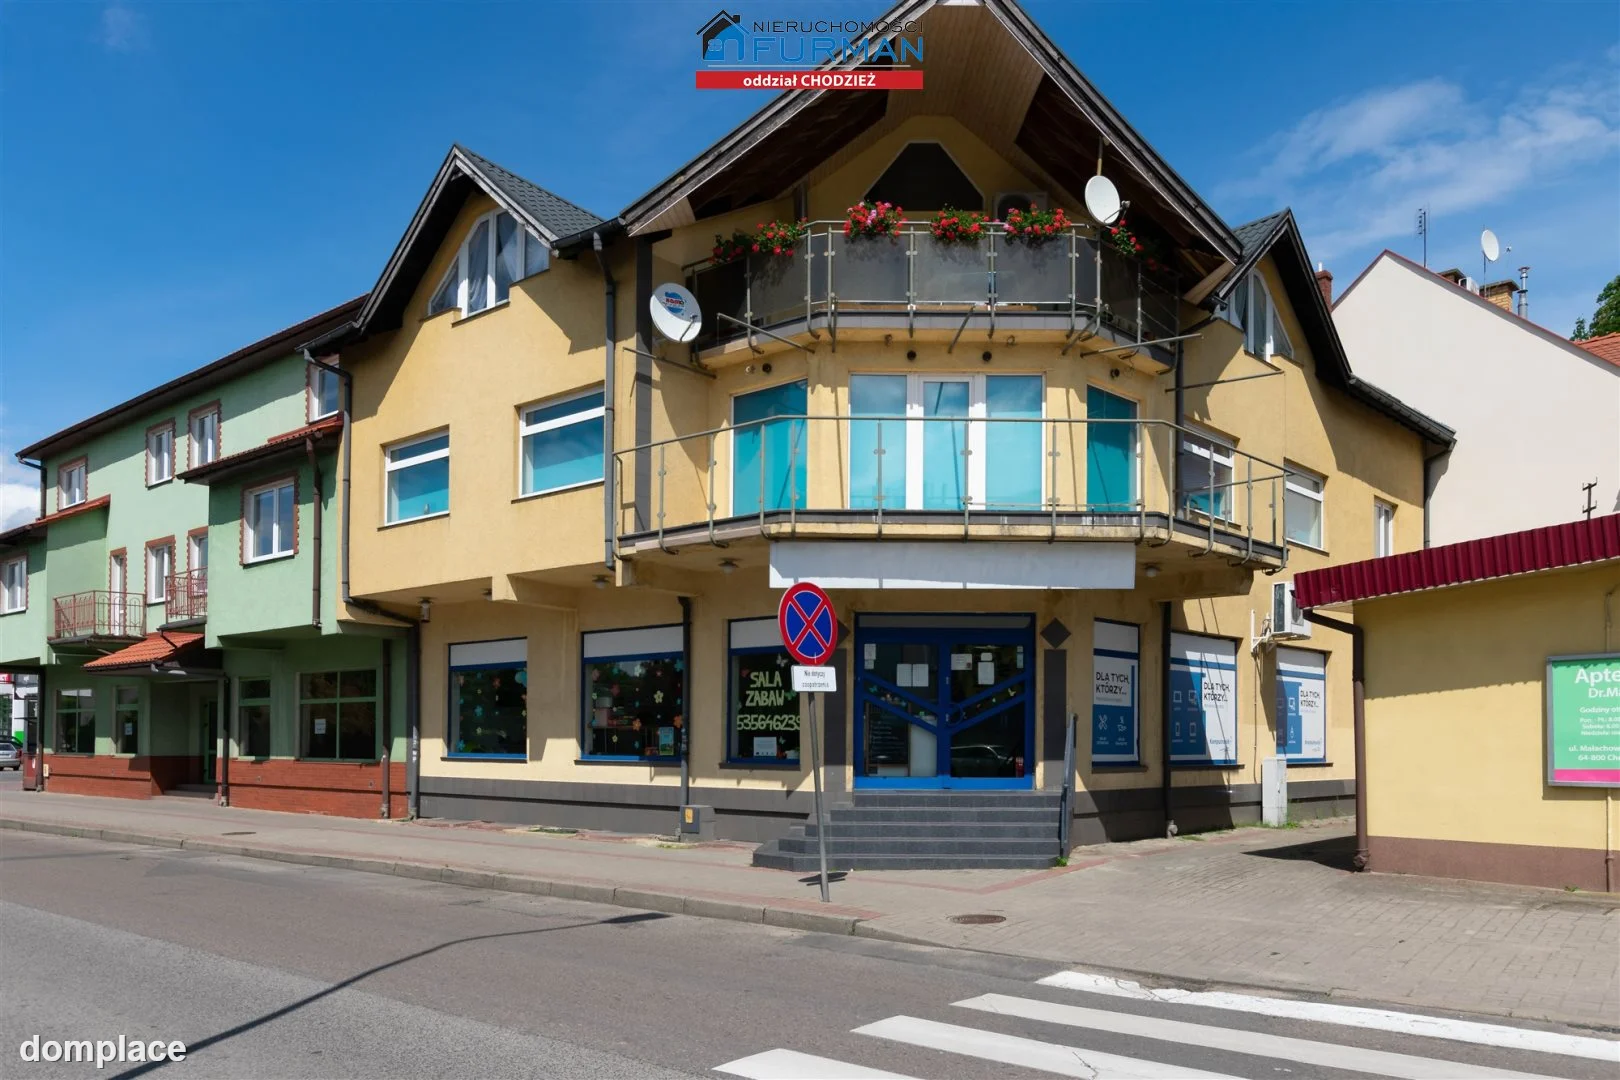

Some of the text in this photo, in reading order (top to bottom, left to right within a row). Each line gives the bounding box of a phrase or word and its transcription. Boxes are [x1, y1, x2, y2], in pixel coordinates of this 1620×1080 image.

[750, 671, 782, 688] SALA
[1096, 672, 1110, 682] DLA
[1574, 667, 1620, 688] Apte
[1203, 682, 1214, 690] DLA
[745, 690, 785, 707] ZABAW
